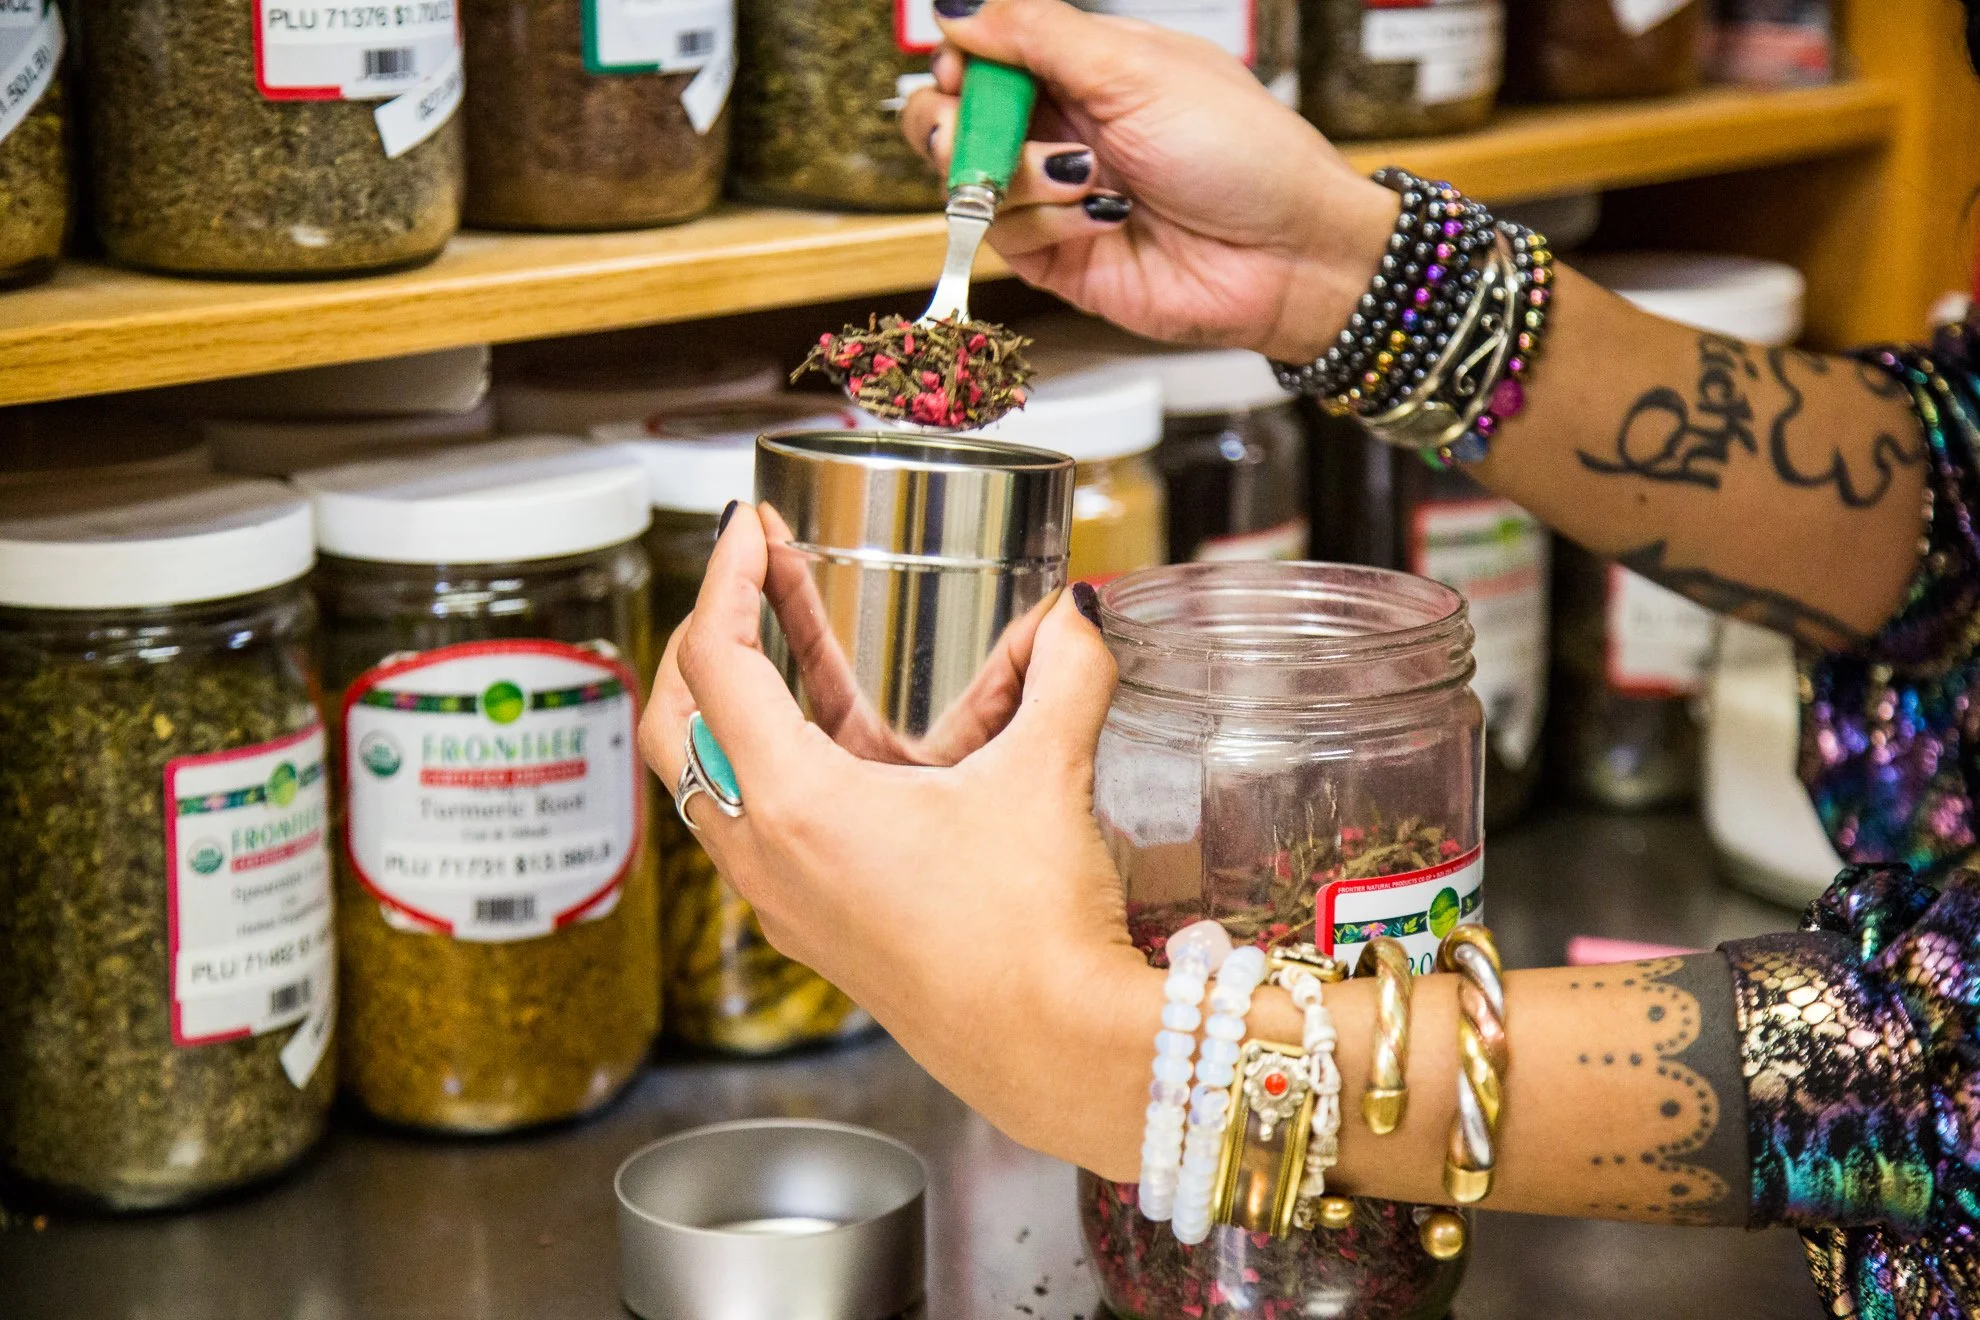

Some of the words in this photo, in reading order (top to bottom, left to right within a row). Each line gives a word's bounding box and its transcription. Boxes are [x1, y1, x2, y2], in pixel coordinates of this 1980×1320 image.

[268, 8, 318, 30] PLU
[324, 7, 387, 29] 71376
[421, 725, 589, 763] FRONTIER
[420, 797, 524, 821] Turmeric
[535, 793, 588, 815] Root
[385, 855, 433, 877] PLU
[1337, 885, 1366, 894] FRONTIER
[1366, 881, 1391, 892] NATURAL
[1391, 876, 1418, 889] PRODUCTS
[191, 959, 241, 984] PLU
